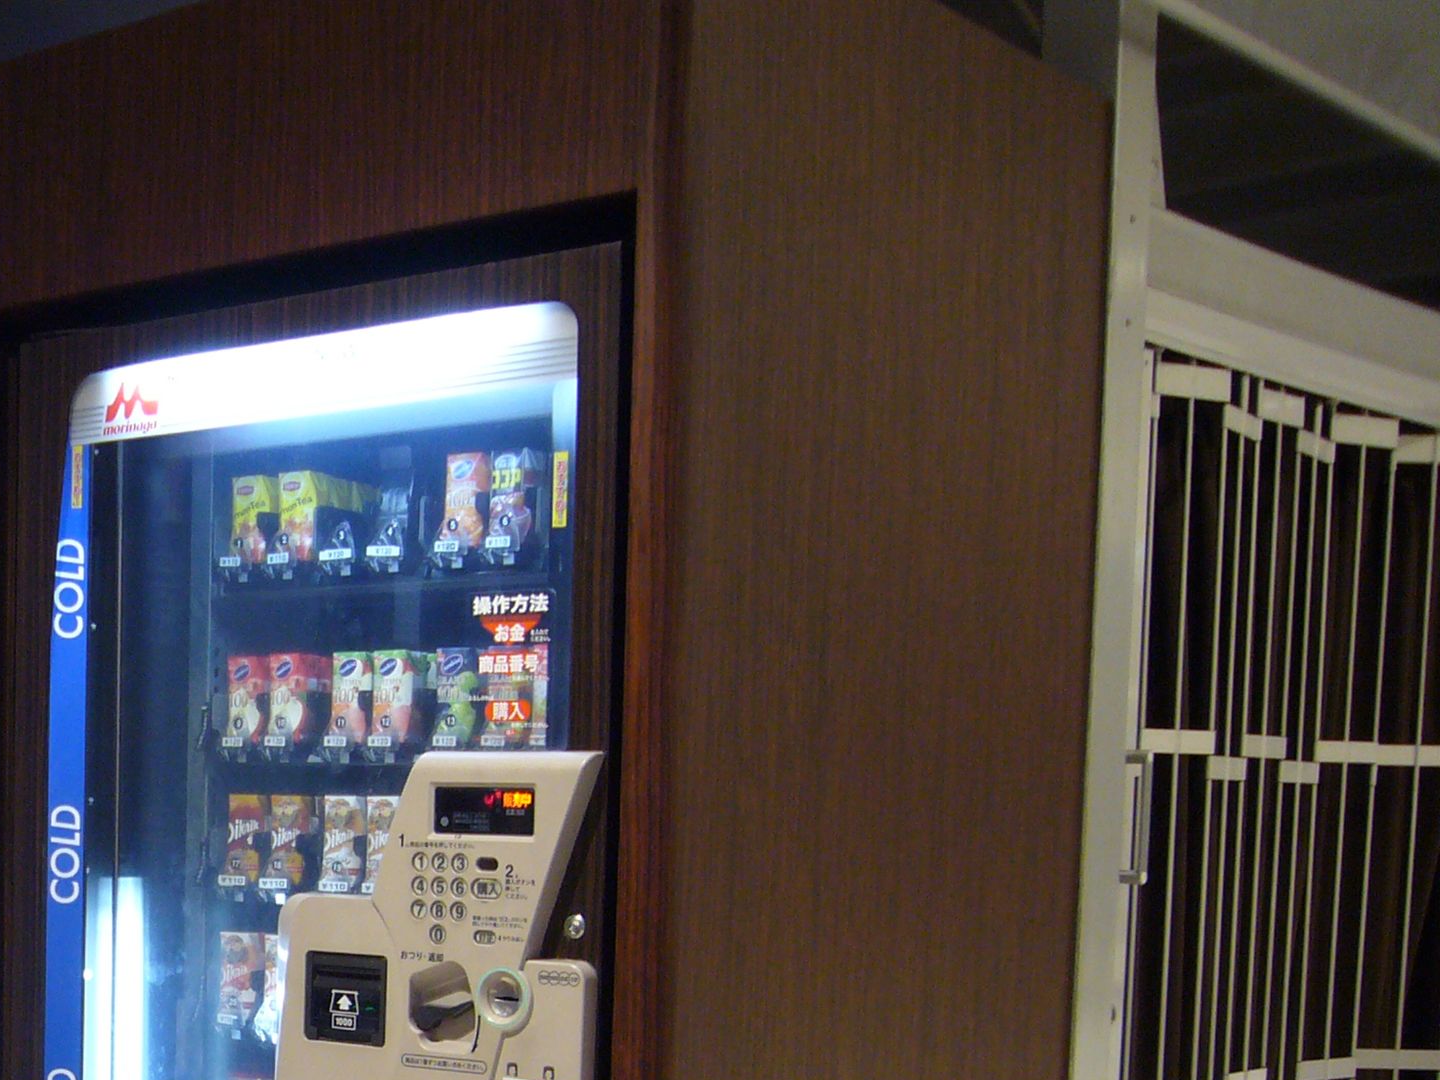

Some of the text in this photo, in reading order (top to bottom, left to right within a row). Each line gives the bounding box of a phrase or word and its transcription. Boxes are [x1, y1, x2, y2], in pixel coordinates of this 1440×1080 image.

[54, 538, 85, 638] COLD
[472, 592, 550, 617] 操作方法
[493, 623, 526, 643] お金
[478, 654, 540, 675] 商品番号
[492, 701, 526, 721] 購入
[50, 804, 81, 904] COLD
[416, 853, 426, 870] 1
[434, 853, 447, 871] 2
[454, 854, 467, 872] 3
[414, 877, 426, 893] 4
[434, 878, 447, 894] 5
[454, 878, 466, 896] 6
[413, 902, 425, 919] 7
[433, 903, 445, 920] 8
[453, 903, 466, 920] 9
[433, 926, 444, 942] 0
